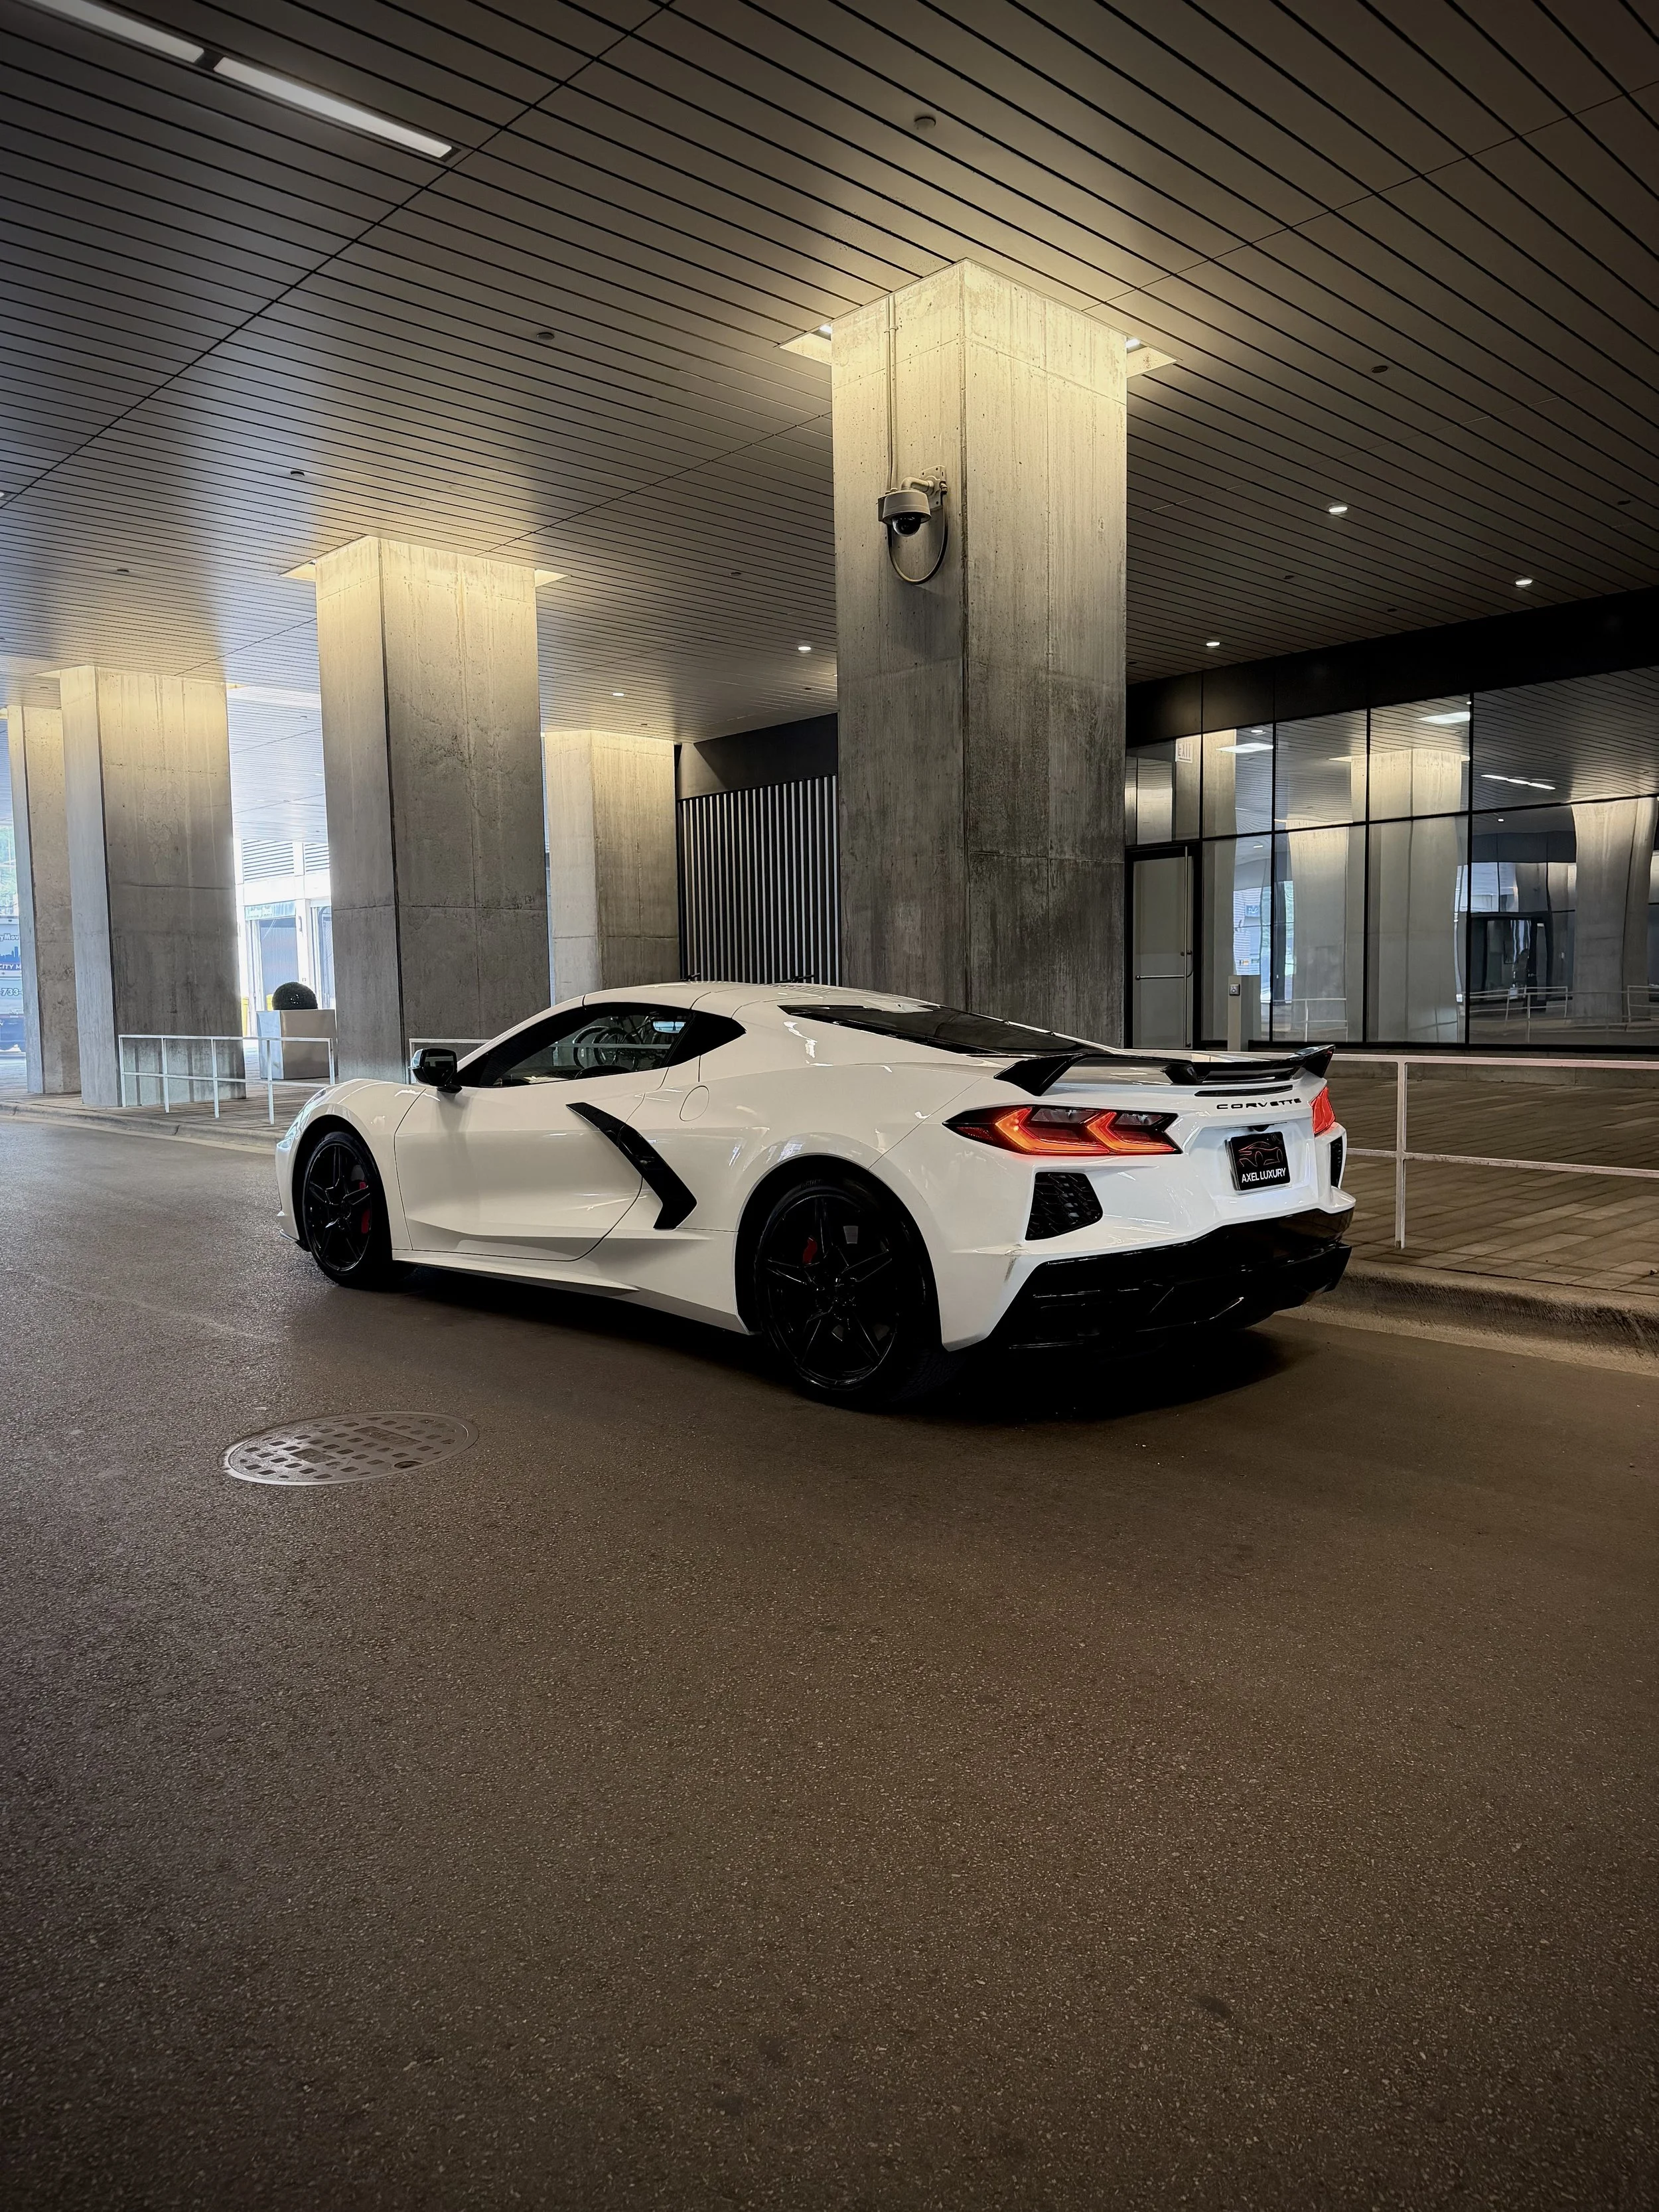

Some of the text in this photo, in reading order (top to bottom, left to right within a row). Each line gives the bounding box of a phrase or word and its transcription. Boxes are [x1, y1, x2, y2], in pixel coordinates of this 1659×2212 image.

[1178, 743, 1191, 759] EXIT
[1216, 1098, 1301, 1110] CORVETTE
[1242, 1168, 1286, 1183] AXEL LUXURY
